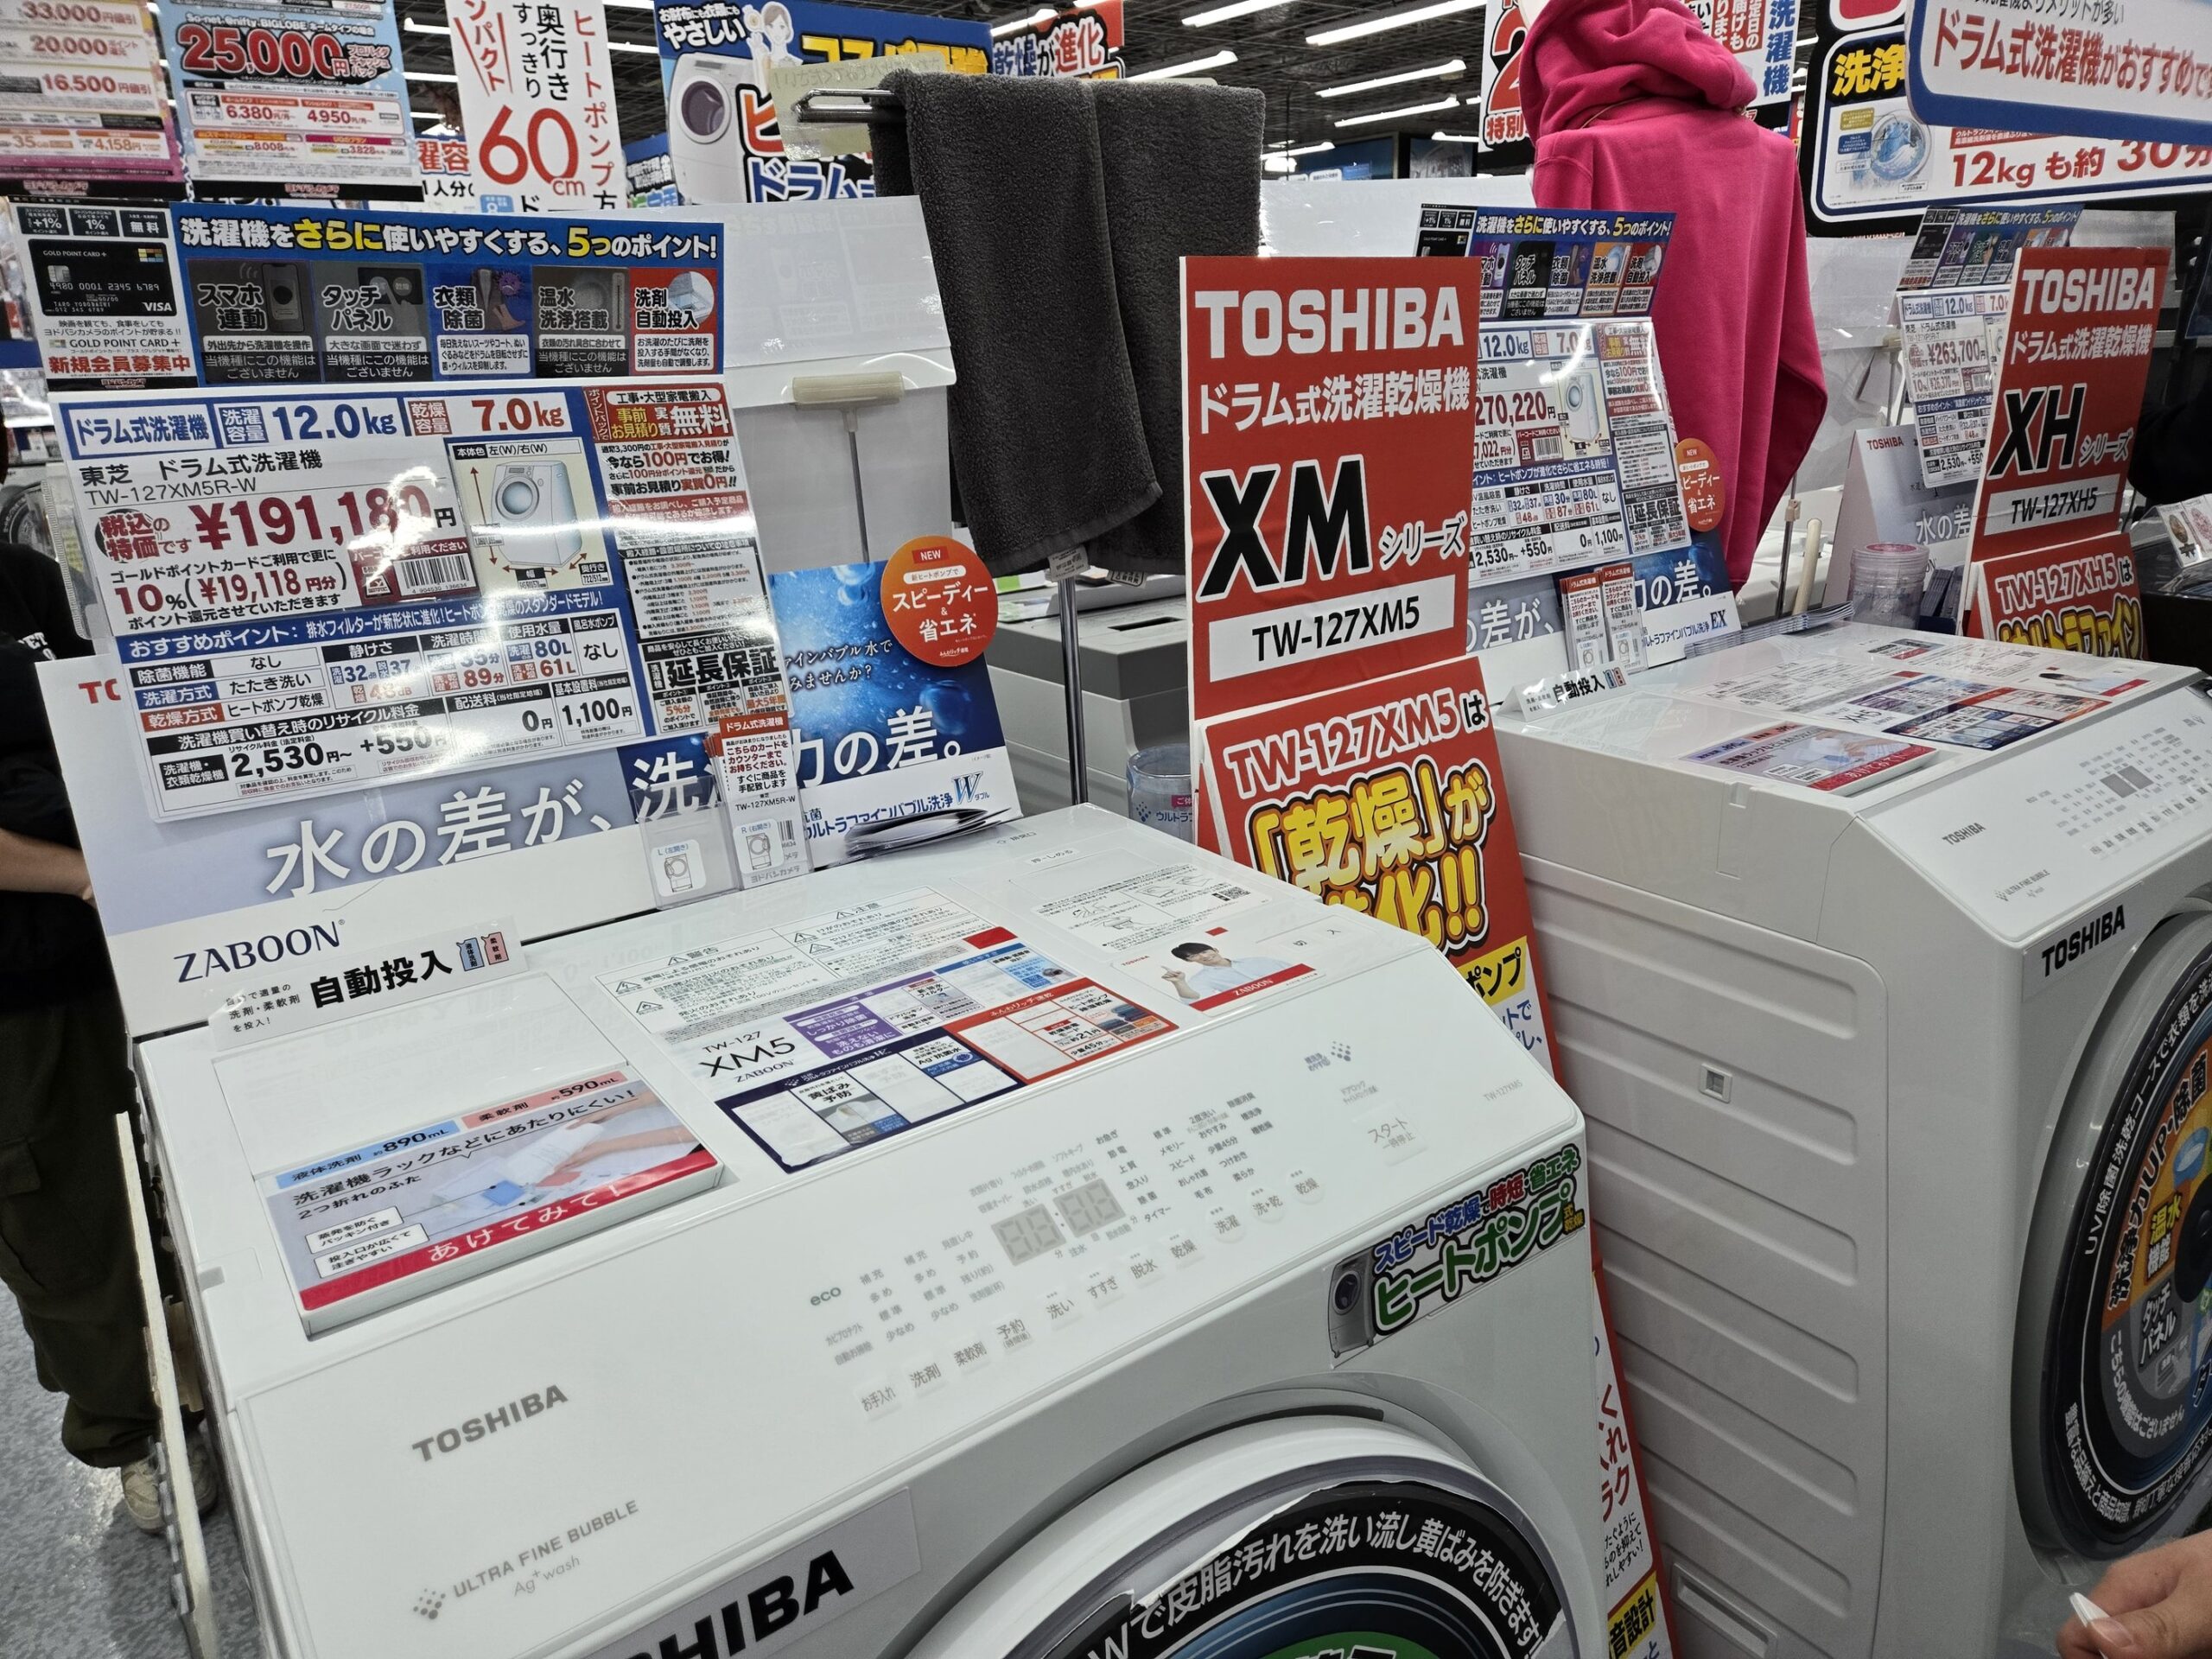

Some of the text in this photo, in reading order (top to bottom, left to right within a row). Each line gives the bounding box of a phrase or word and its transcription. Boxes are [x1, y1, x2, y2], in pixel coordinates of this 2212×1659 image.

[658, 3, 741, 23] お財布にも衣類にも
[664, 18, 747, 48] やさしい
[512, 3, 542, 99] すっきり
[537, 3, 569, 101] 奥行き
[994, 17, 1104, 79] 乾燥が進化
[1763, 0, 1796, 97] 洗濯機
[574, 10, 614, 187] ヒートポンプ
[1952, 151, 2036, 189] 12kg
[2046, 147, 2105, 180] も約
[130, 221, 160, 234] 無料
[180, 217, 718, 259] 洗濯機をさらに使いやすくする、5つのポイント!
[197, 283, 263, 307] スマホ
[321, 283, 383, 306] タッチ
[434, 286, 476, 308] 衣類
[538, 287, 575, 308] 温水
[635, 288, 669, 308] 洗剤
[2022, 266, 2154, 315] TOSHIBA
[142, 302, 172, 312] VISA
[218, 308, 268, 331] 連動
[539, 309, 610, 330] 洗浄搭載
[59, 320, 164, 328] 映画を観ても、食事をしても
[332, 309, 392, 331] パネル
[442, 309, 484, 331] 除菌
[636, 310, 700, 330] 自動投入
[1194, 286, 1465, 359] TOSHIBA
[69, 338, 168, 348] GOLD POINT CARD
[207, 339, 312, 353] 外出先から洗濯機を操作
[329, 339, 421, 352] 大きな画面で迷わず
[1483, 332, 1529, 359] 12.0kg
[2010, 323, 2152, 366] ドラム式洗濯乾燥機
[48, 354, 191, 374] 新規会員募集中
[206, 354, 317, 367] 当機種にこの機能は
[327, 354, 429, 366] 当機種にこの機能は
[538, 351, 626, 363] 当機種にこの機能は
[226, 367, 300, 379] ございません
[616, 390, 712, 404] 工事・大型家電搬入
[1199, 365, 1471, 435] ドラム式洗濯乾燥機
[272, 403, 397, 441] 12.0kg
[471, 397, 565, 432] 7.0kg
[616, 407, 647, 423] 事前
[670, 404, 730, 435] 無料
[75, 413, 210, 447] ドラム式洗濯機
[611, 423, 658, 439] お見積り
[1988, 383, 2135, 480] XH シリーズ
[456, 446, 486, 459] 本体色
[1866, 436, 1904, 450] TOSHIBA
[80, 448, 323, 486] 東芝 ドラム式洗濯機
[85, 476, 257, 505] TW-127XM5R-W
[1601, 492, 1617, 505] なし
[1472, 503, 1502, 515] たたき洗い
[1688, 494, 1716, 513] 省エネ
[2011, 486, 2098, 525] TW-127XH5
[1196, 454, 1467, 602] XM シリーズ
[1594, 527, 1624, 547] 1,100円
[110, 548, 337, 585] ゴールドポイントカードご利用で更に
[919, 550, 942, 561] NEW
[893, 582, 988, 613] スピーディー
[128, 594, 341, 631] ポイント還元させていただきます
[573, 615, 616, 631] 風呂水ポンプ
[1710, 609, 1727, 631] EX
[508, 620, 563, 639] 使用水量
[918, 614, 978, 643] 省エネ
[1252, 595, 1421, 663] TW-127XM5
[349, 641, 393, 658] 静けさ
[535, 639, 572, 658] 80L
[583, 642, 619, 660] なし
[137, 654, 283, 684] 除菌機能 なし
[463, 667, 505, 688] 89分
[540, 658, 576, 677] 61L
[664, 646, 779, 688] 延長保証
[143, 673, 313, 707] 洗濯方式 たたき洗い
[1554, 673, 1605, 703] 自動投入
[148, 694, 325, 728] 乾燥方式 ヒートポンプ乾燥
[522, 709, 554, 732] 0円
[562, 697, 632, 728] 1,100円
[177, 702, 421, 750] 洗濯機買い替え時のリサイクル料金
[726, 716, 785, 733] ドラム式洗濯機
[727, 741, 788, 756] こちらのカードを
[1224, 688, 1487, 799] TW-127XM5は
[728, 750, 783, 765] カウンターまで
[729, 760, 788, 774] お持ちください。
[165, 768, 226, 790] 衣類乾燥機
[737, 770, 786, 783] すぐに商品を
[738, 779, 787, 793] 手配致します
[735, 796, 796, 811] TW-127XM5R-W
[1942, 822, 1986, 847] TOSHIBA
[174, 920, 342, 983] ZABOON
[2041, 904, 2126, 978] TOSHIBA
[310, 950, 453, 1008] 自動投入
[1233, 977, 1274, 996] ZABOON
[229, 993, 302, 1020] 洗剤・柔軟剤
[232, 1016, 271, 1033] を投入!
[702, 1031, 762, 1055] TW-127
[698, 1037, 796, 1078] XM5
[736, 1060, 793, 1084] ZABOON
[478, 1100, 530, 1122] 柔軟剤
[1367, 1116, 1409, 1145] スタート
[293, 1088, 636, 1206] 洗濯機ラックなどにあたりにくい!
[291, 1153, 363, 1182] 液体洗剤
[298, 1173, 422, 1220] 2つ折れのふた
[1294, 1176, 1320, 1196] 乾燥
[318, 1215, 378, 1240] 蒸発を防ぐ
[321, 1219, 391, 1248] パッキン付き
[429, 1183, 621, 1263] あけてみて!
[1214, 1214, 1241, 1235] 洗濯
[327, 1230, 412, 1265] 投入口が広くて
[331, 1243, 395, 1271] 注ぎやすい
[1169, 1237, 1198, 1262] 乾燥
[1376, 1179, 1573, 1328] ヒートポンプ
[1130, 1255, 1159, 1281] 脱水
[810, 1286, 842, 1306] eco
[1087, 1275, 1119, 1300] すすぎ
[1046, 1299, 1076, 1321] 洗い
[995, 1318, 1026, 1341] 予約
[953, 1341, 988, 1369] 柔軟剤
[908, 1363, 942, 1389] 洗剤
[861, 1385, 897, 1413] お手入れ
[411, 1383, 569, 1463] TOSHIBA
[453, 1500, 639, 1599] ULTRA FINE BUBBLE
[624, 1550, 855, 1659] HIBA
